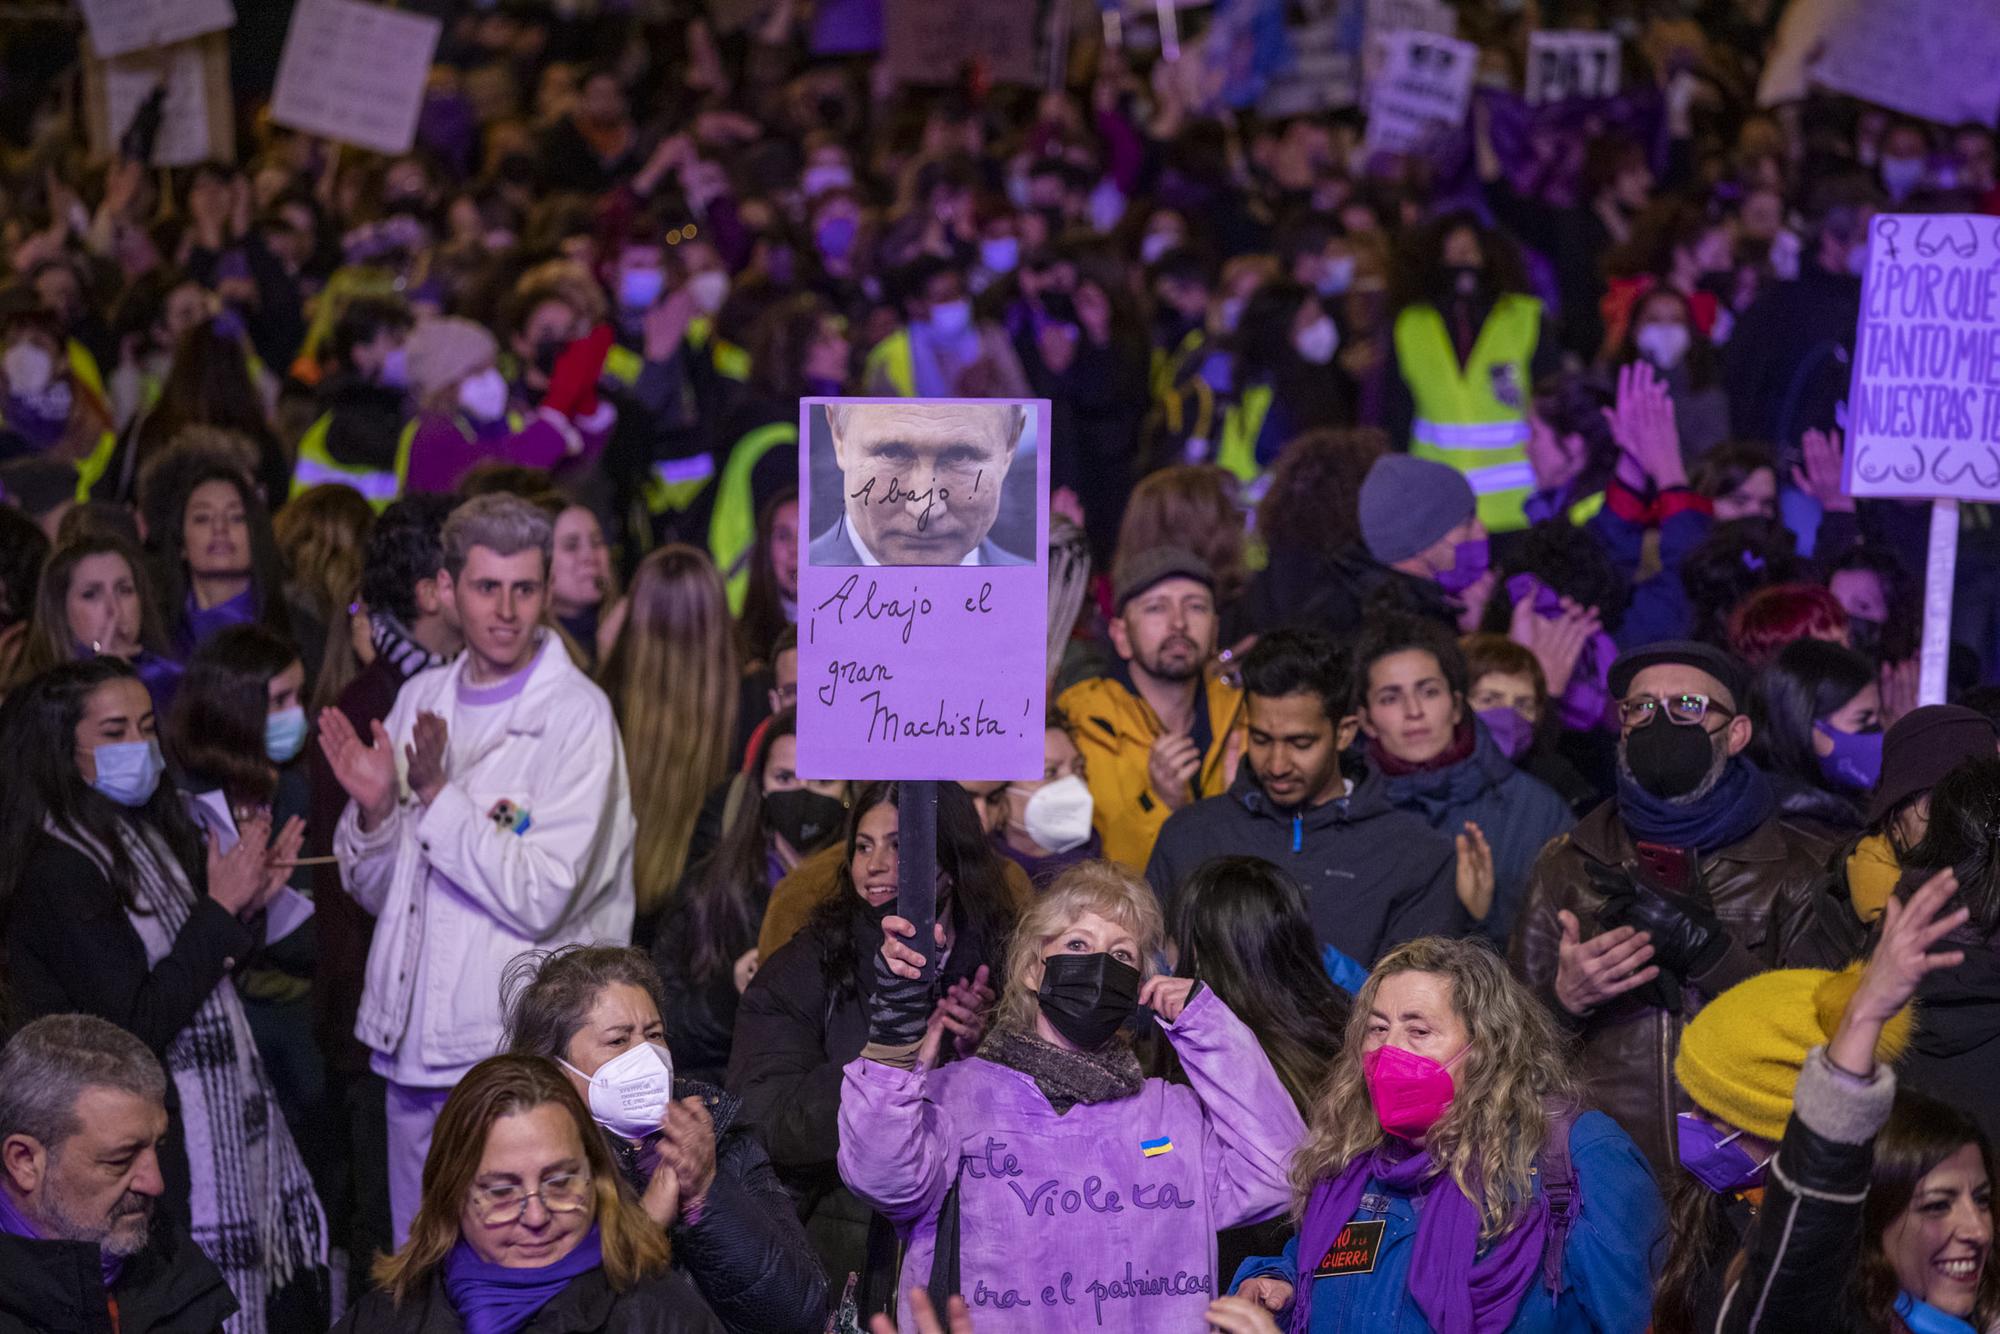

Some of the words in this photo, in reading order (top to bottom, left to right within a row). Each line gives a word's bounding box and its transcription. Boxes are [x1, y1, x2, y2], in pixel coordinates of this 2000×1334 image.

[1864, 322, 1950, 380] TANTO
[1859, 384, 1978, 442] NUESTRAS
[810, 574, 932, 644] ¡Abajo
[965, 582, 993, 613] el
[818, 660, 893, 707] gran
[1322, 1250, 1369, 1269] GUERRA
[1040, 1271, 1076, 1306] el
